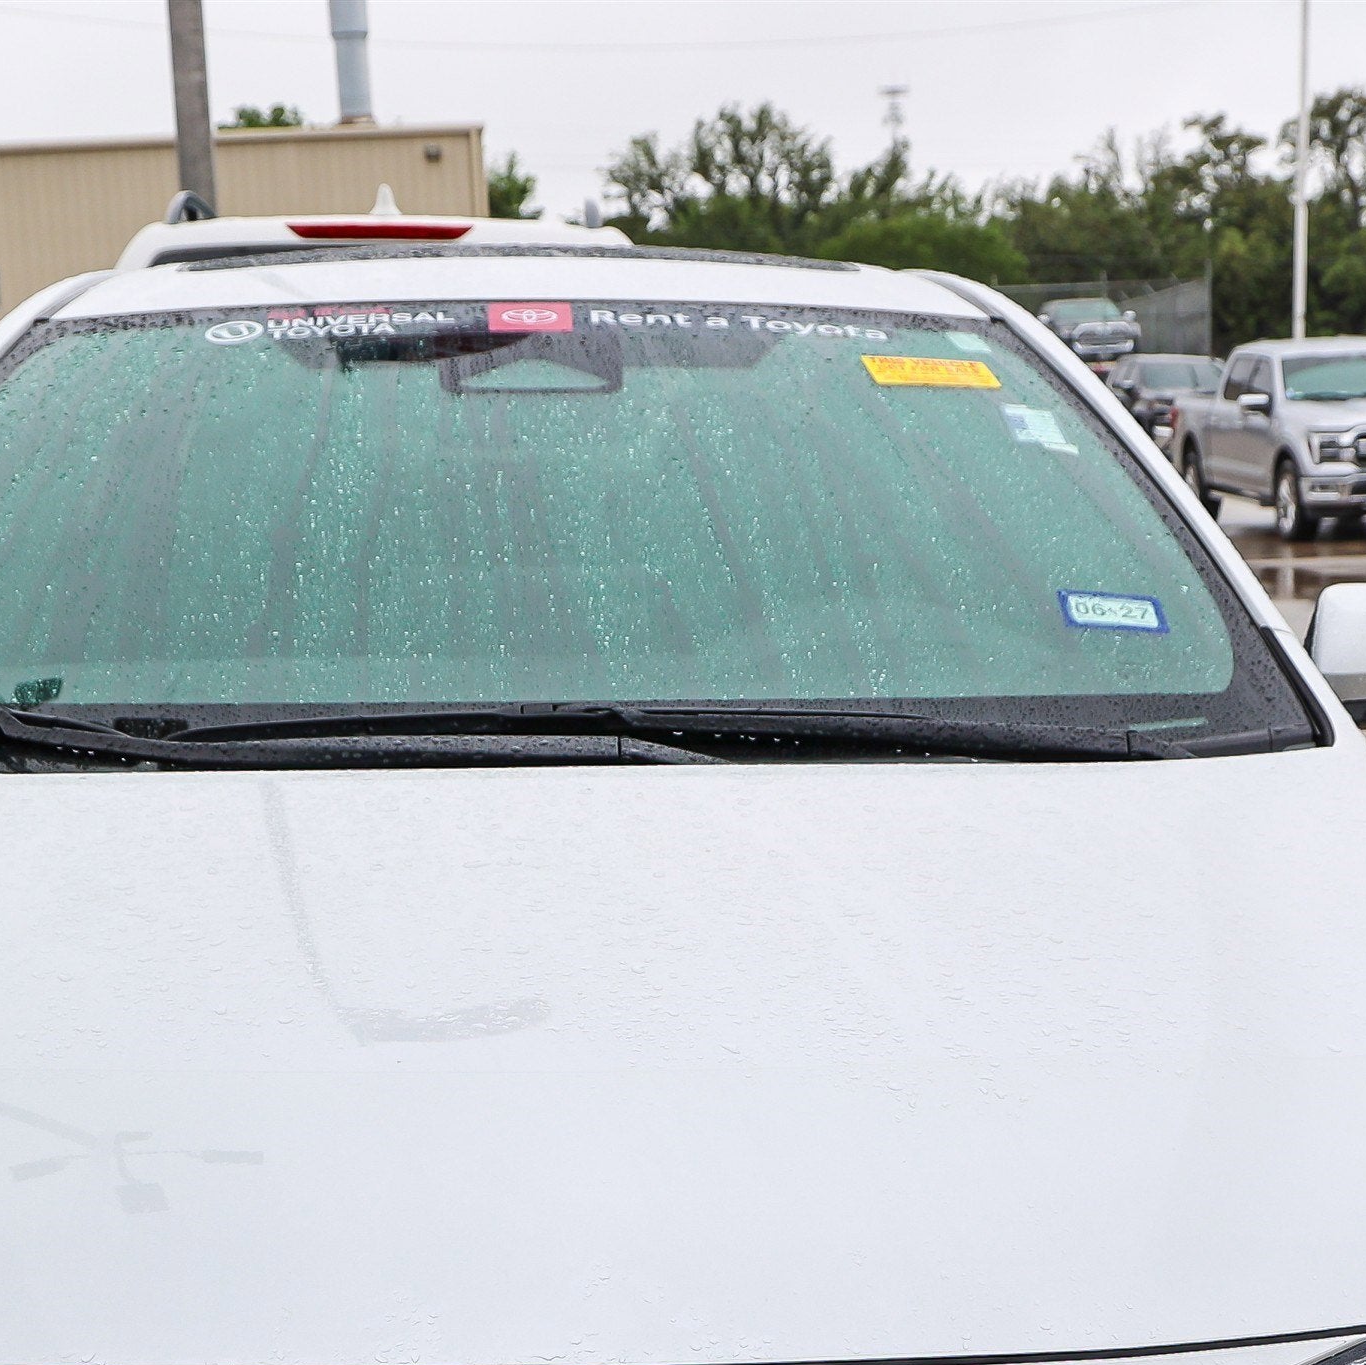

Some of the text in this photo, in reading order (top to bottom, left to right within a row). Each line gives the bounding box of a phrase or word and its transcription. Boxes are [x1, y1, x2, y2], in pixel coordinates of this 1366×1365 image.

[267, 311, 455, 329] UNIVERSAL
[589, 309, 889, 342] Rent a Toyota
[267, 324, 397, 341] TOYOTA
